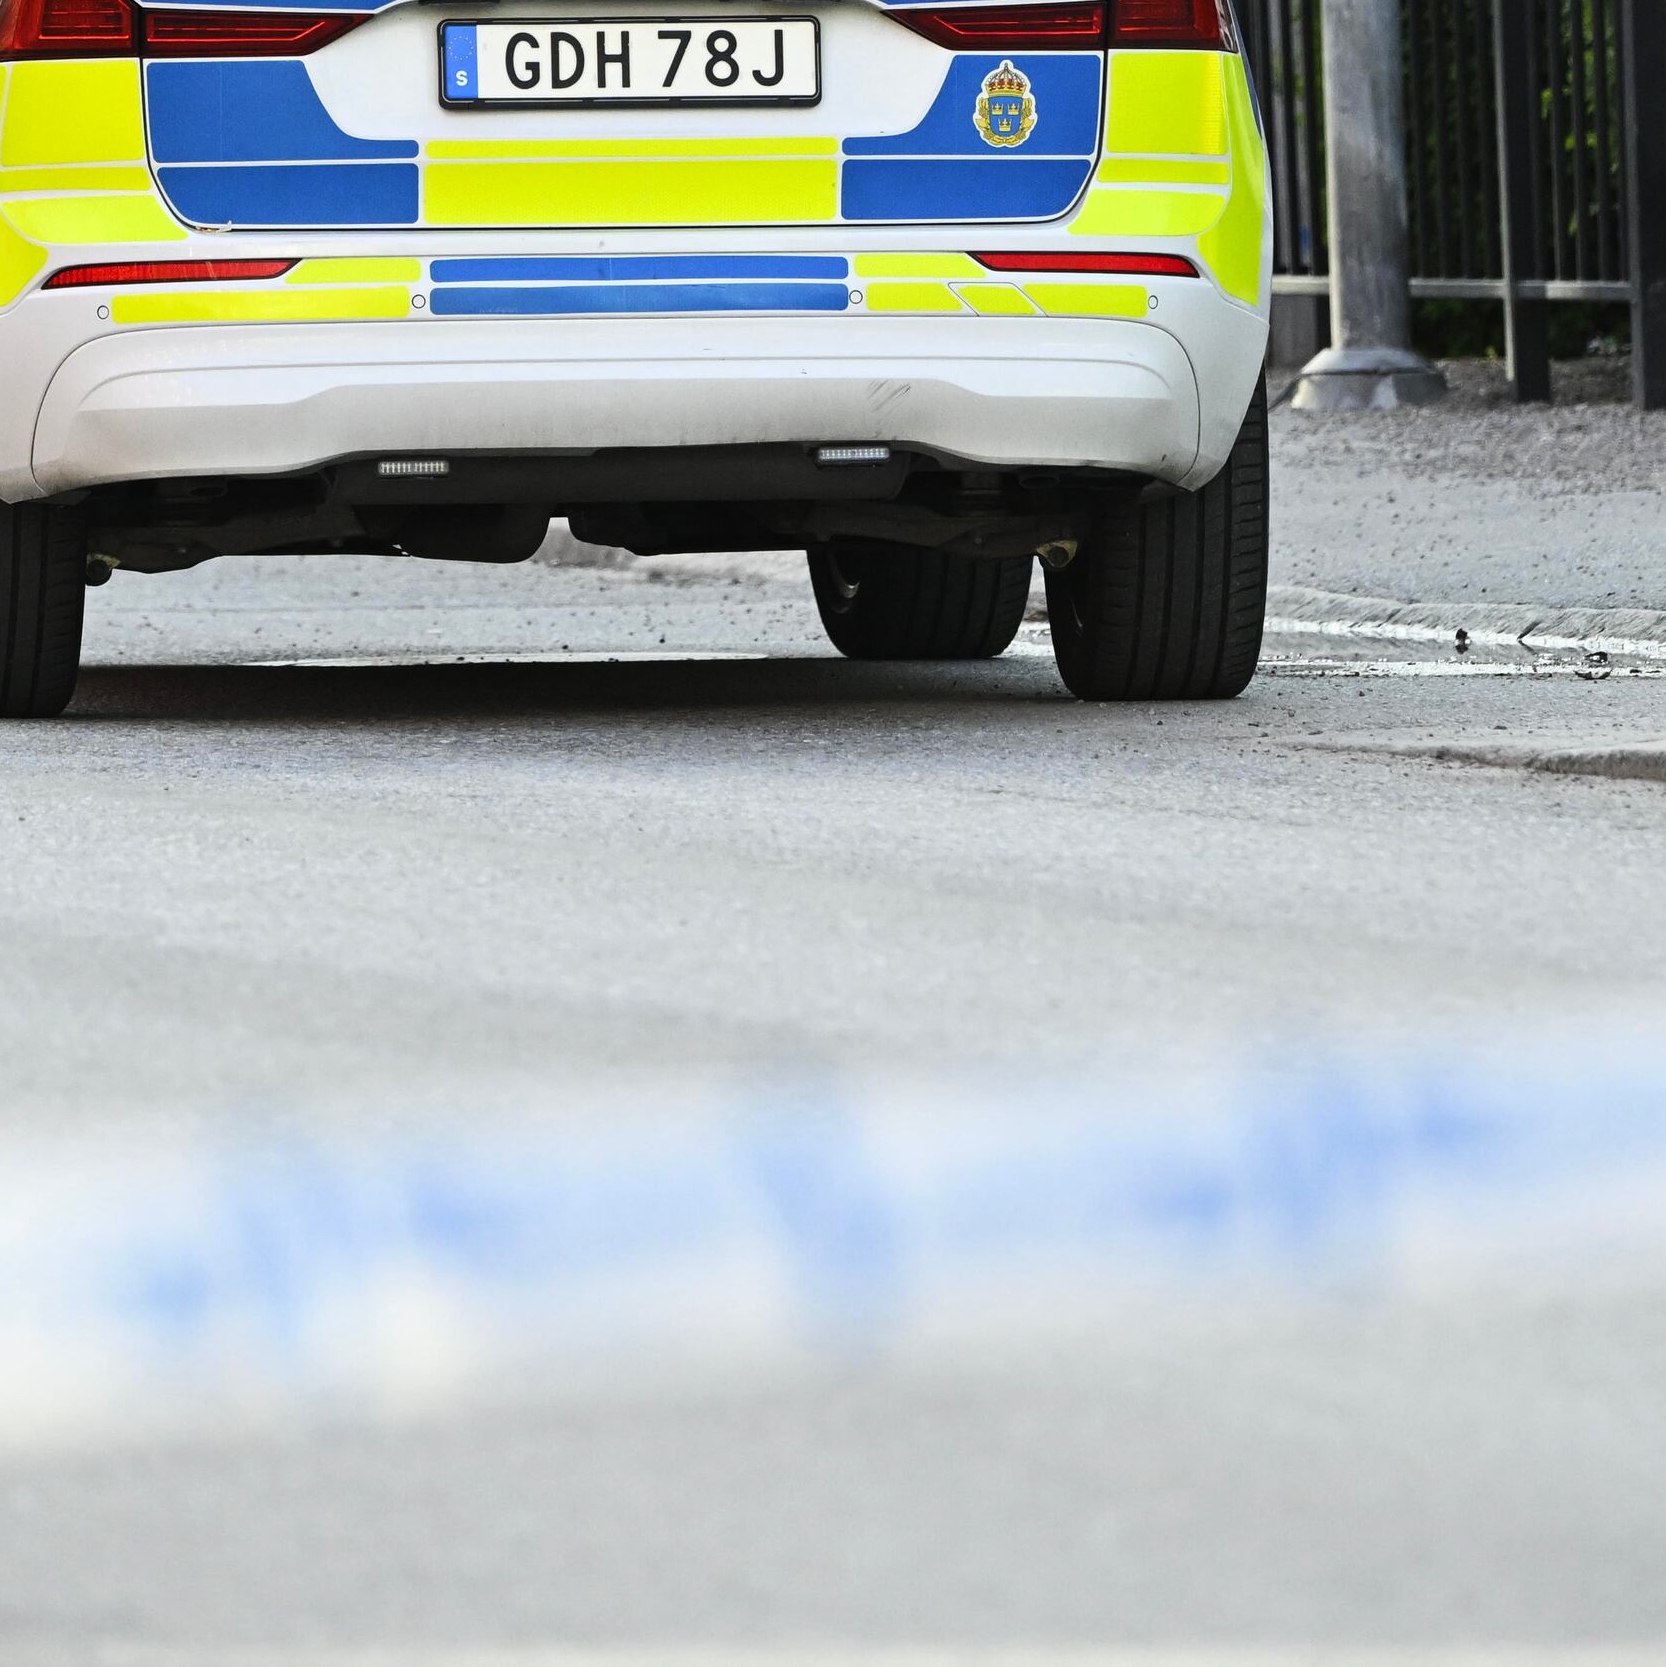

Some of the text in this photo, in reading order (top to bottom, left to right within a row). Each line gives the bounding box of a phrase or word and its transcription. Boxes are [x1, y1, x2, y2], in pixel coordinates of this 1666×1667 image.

[455, 70, 469, 88] S
[505, 29, 785, 90] GDH 78J
